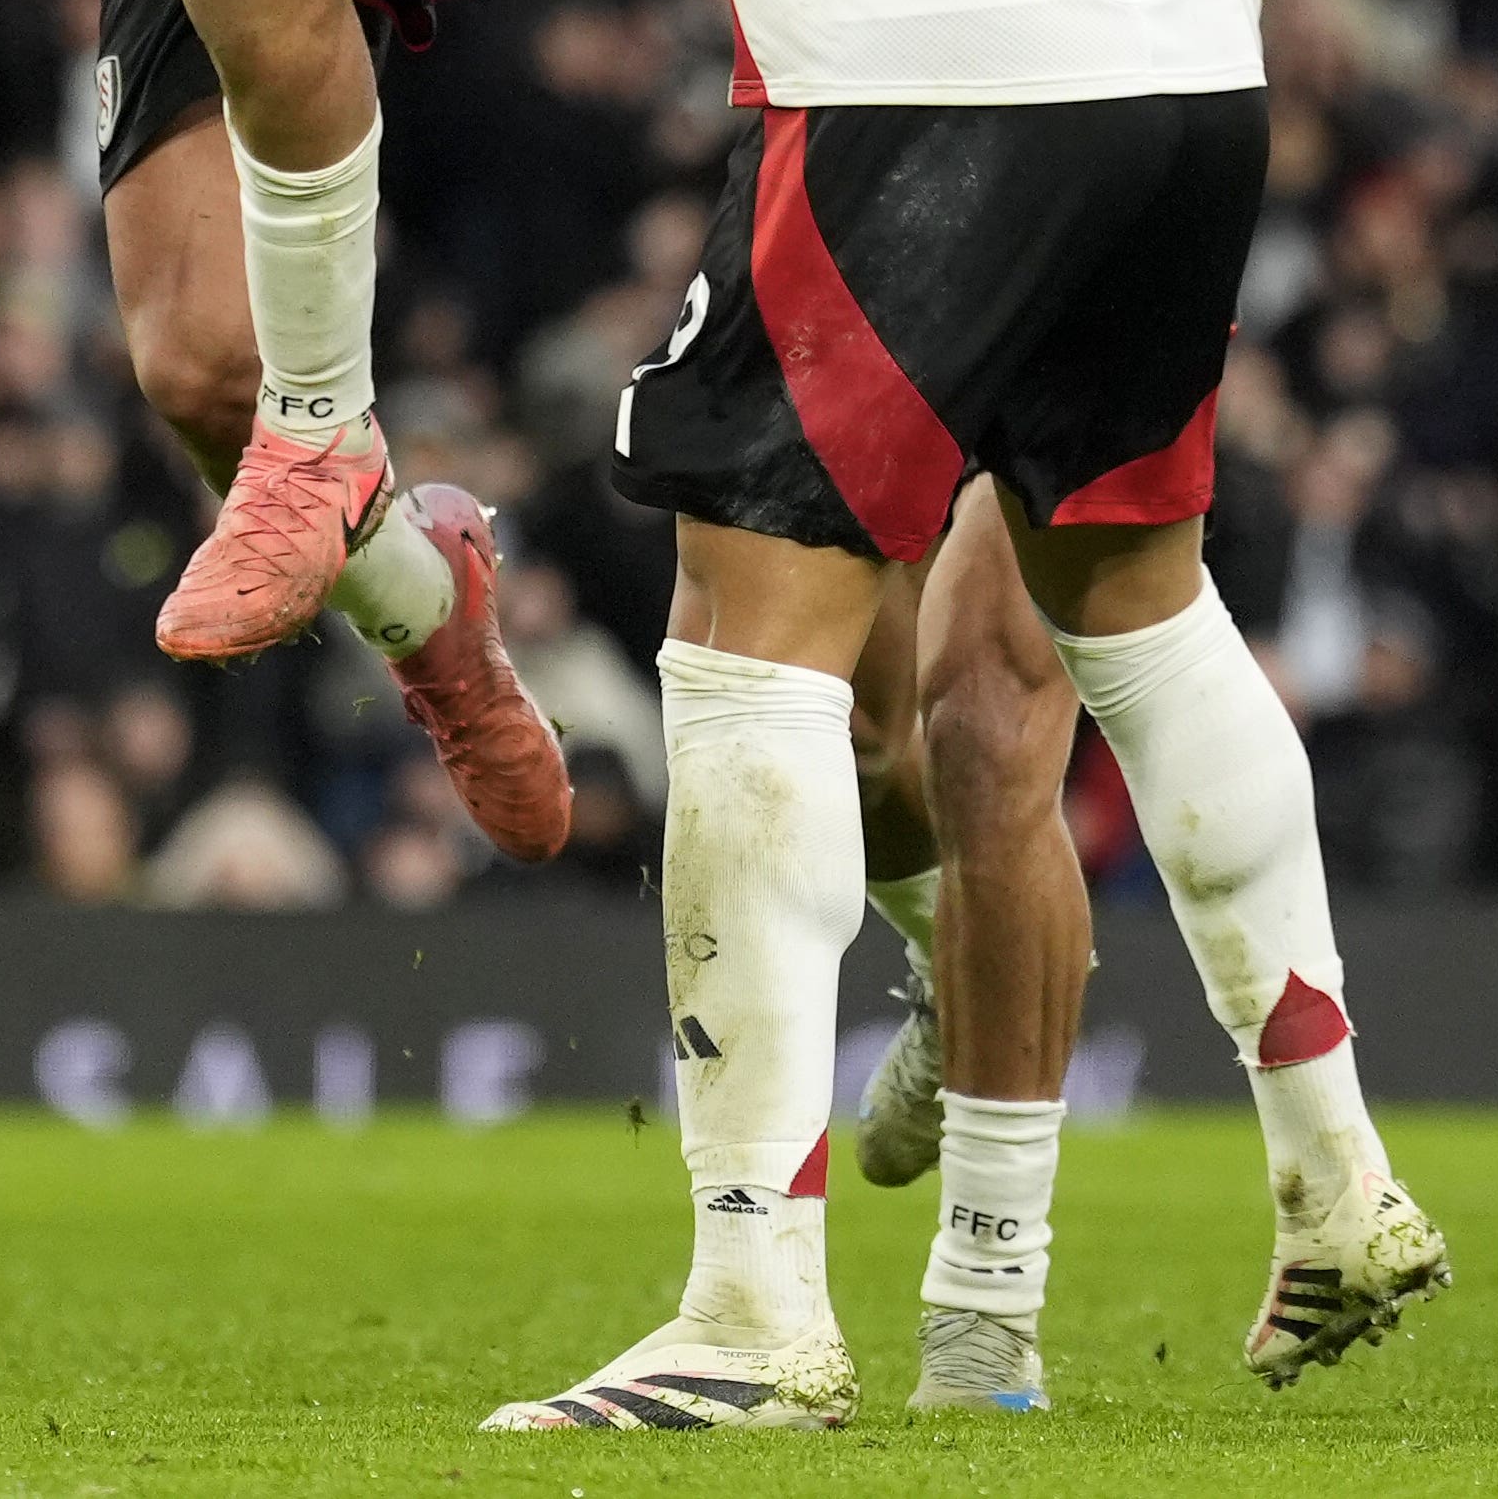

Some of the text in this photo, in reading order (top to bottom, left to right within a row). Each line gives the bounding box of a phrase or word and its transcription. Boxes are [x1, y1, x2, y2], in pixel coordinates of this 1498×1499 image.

[262, 384, 334, 419] FFC
[707, 1202, 769, 1215] adidas
[951, 1204, 1020, 1241] FFC
